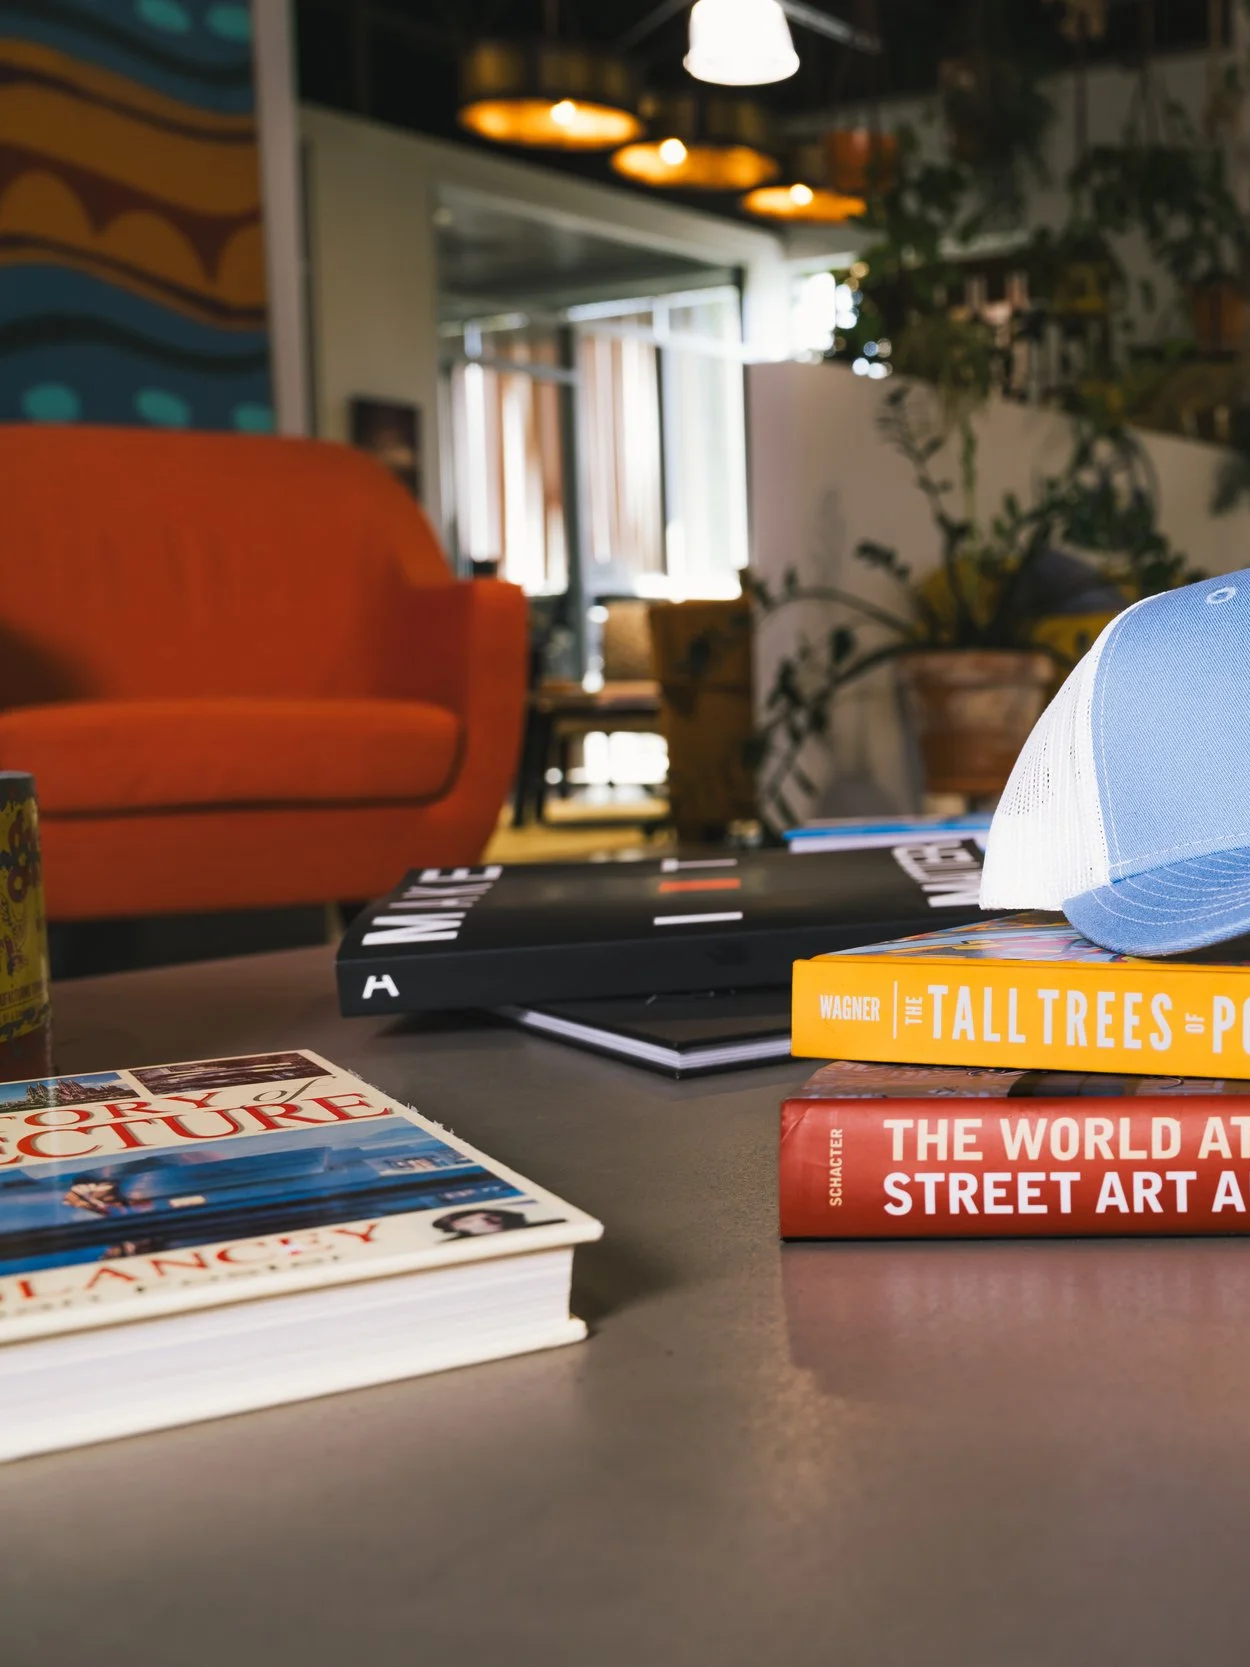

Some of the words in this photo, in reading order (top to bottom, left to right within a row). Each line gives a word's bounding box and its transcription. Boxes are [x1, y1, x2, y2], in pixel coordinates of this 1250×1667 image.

[361, 865, 503, 946] MAKE
[819, 994, 880, 1022] WAGNER
[905, 996, 923, 1025] THE
[927, 984, 1026, 1044] TALL
[1038, 988, 1173, 1051] TREES
[1185, 1013, 1204, 1034] OF
[0, 1091, 222, 1128] ORY
[253, 1076, 337, 1105] of
[829, 1128, 843, 1207] SCHACTER
[883, 1118, 983, 1162] THE
[1000, 1117, 1181, 1162] WORLD
[883, 1171, 1081, 1216] STREET
[1096, 1171, 1197, 1214] ART
[0, 1223, 379, 1300] LANCEY
